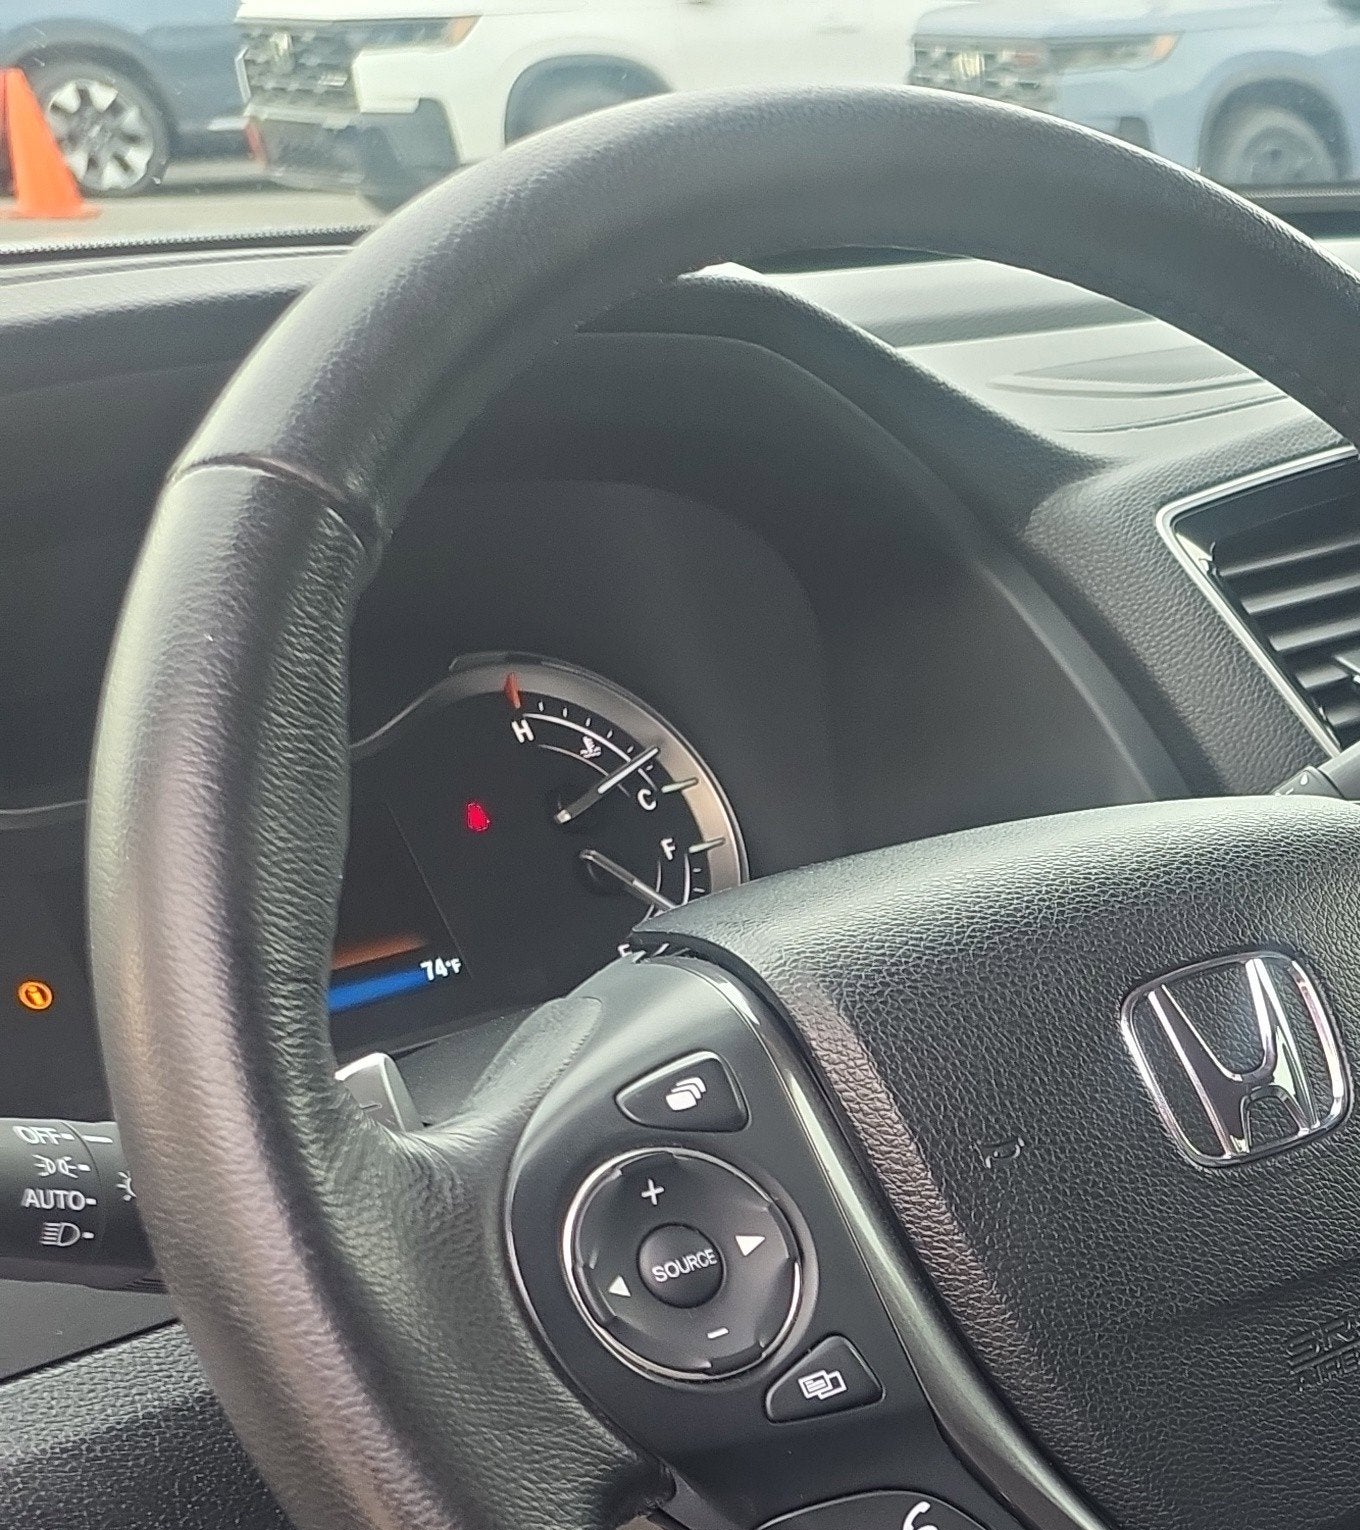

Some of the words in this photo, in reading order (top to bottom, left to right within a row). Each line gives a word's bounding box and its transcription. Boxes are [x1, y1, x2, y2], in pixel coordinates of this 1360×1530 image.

[12, 1125, 60, 1145] OFF
[21, 1188, 87, 1211] AUTO
[652, 1248, 718, 1283] SOURCE
